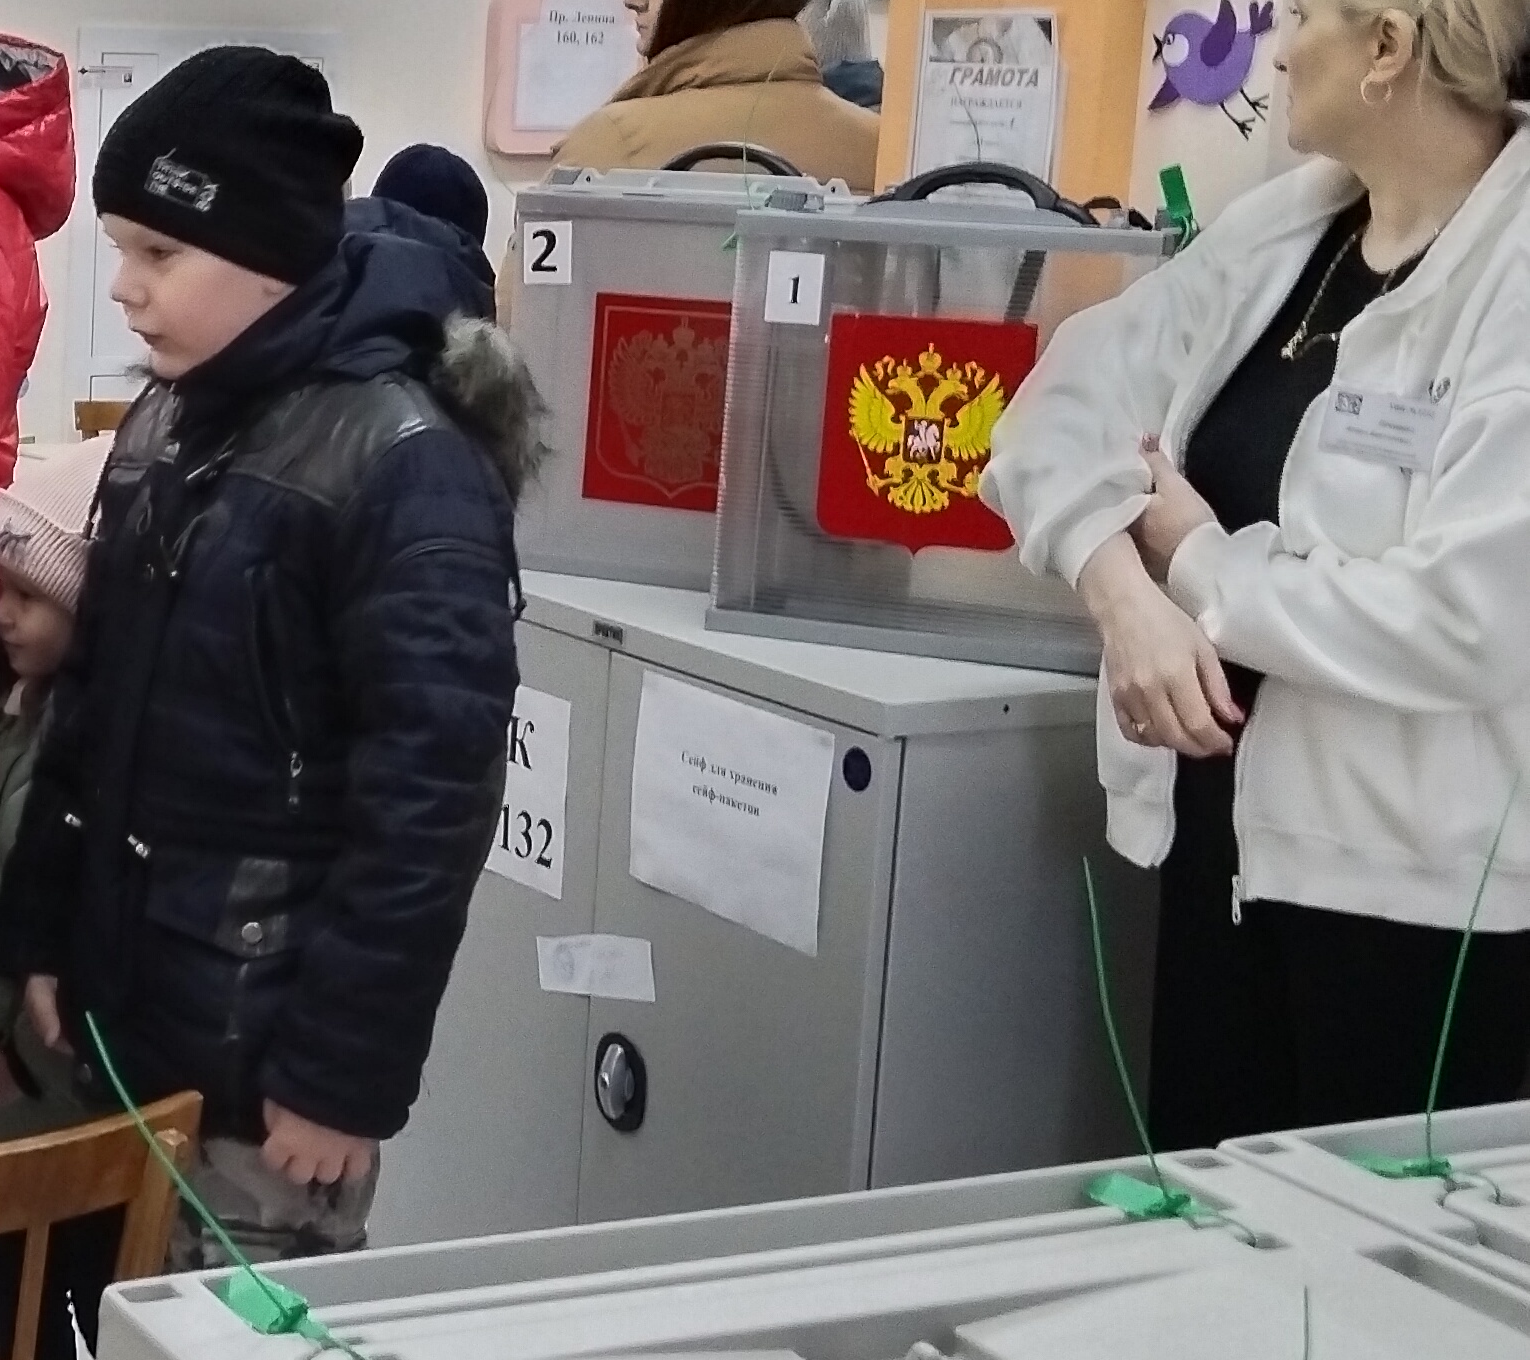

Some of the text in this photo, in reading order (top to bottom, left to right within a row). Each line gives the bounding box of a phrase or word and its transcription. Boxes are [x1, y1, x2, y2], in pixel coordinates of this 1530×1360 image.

[948, 66, 1040, 88] ГРАМОТА
[531, 229, 558, 272] 2
[788, 275, 800, 304] 1
